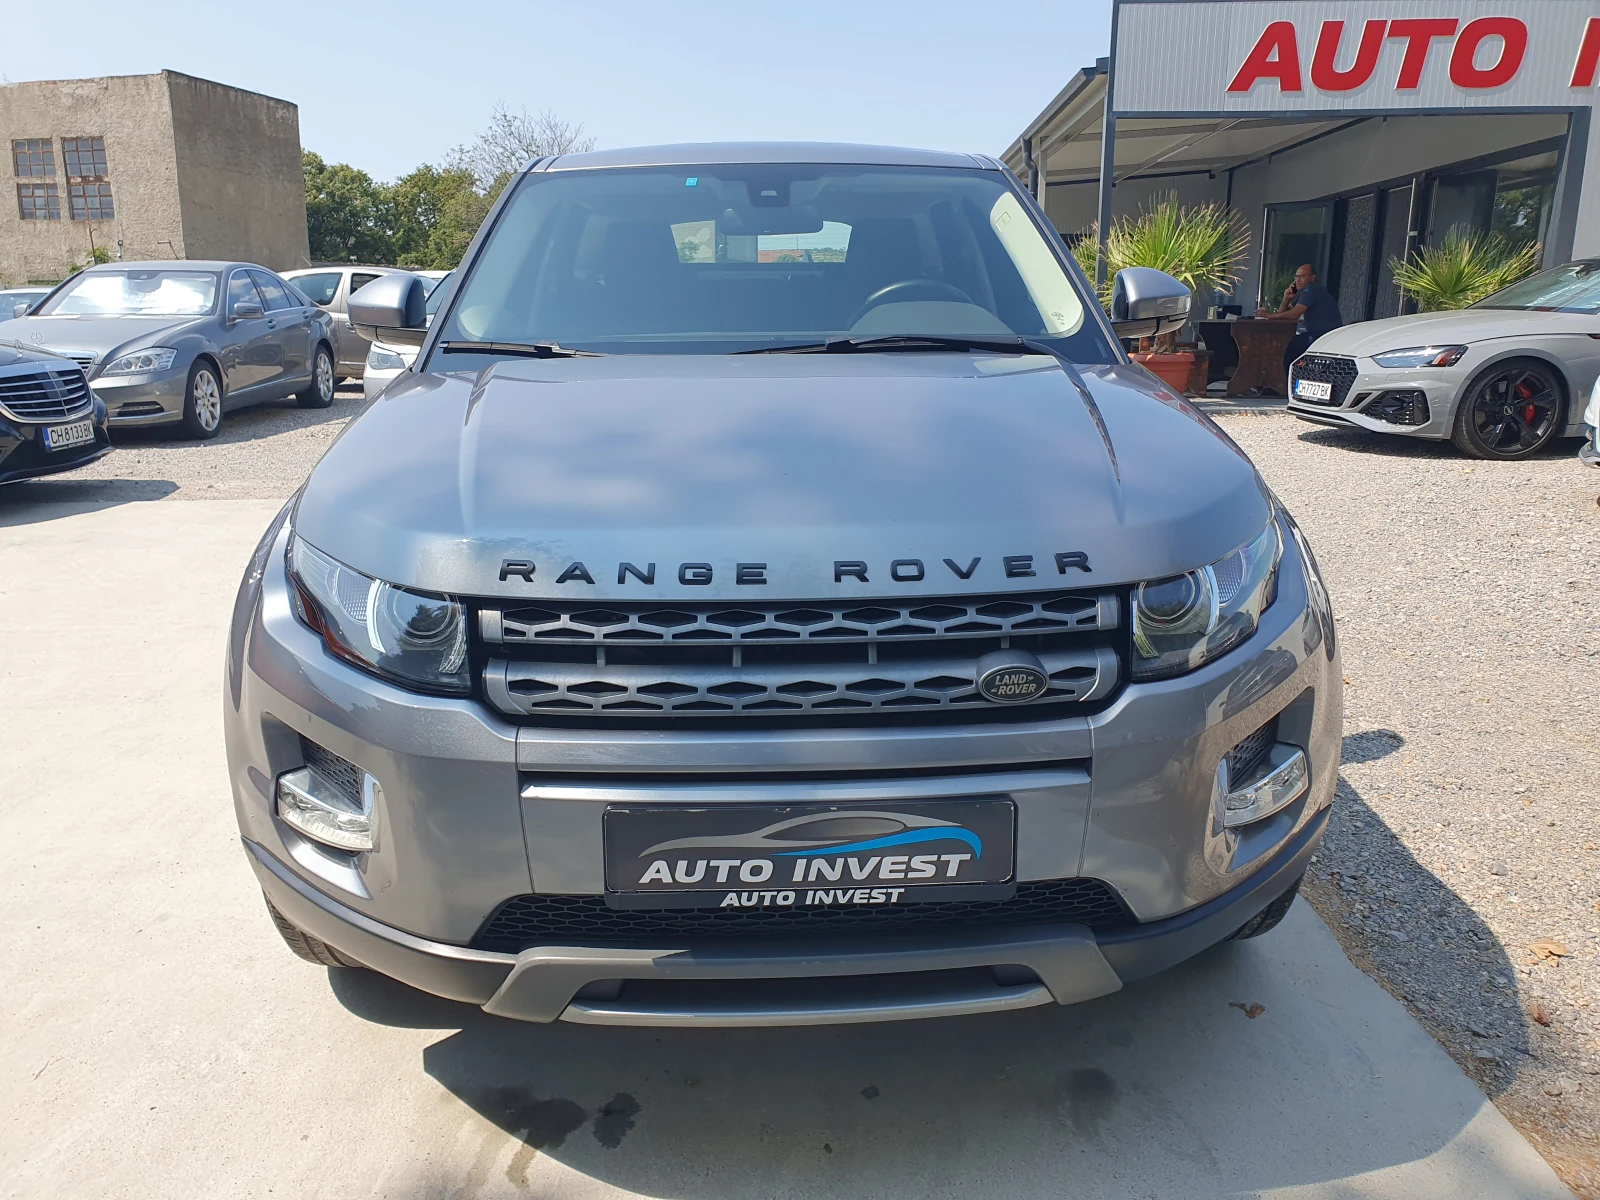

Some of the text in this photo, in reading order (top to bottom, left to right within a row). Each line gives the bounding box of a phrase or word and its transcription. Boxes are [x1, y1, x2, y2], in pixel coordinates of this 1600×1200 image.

[1226, 16, 1528, 92] AUTO
[499, 551, 1092, 585] RANGE ROVER
[995, 674, 1027, 685] LAND
[998, 684, 1036, 695] ROVER
[638, 854, 971, 883] AUTO INVEST
[720, 888, 905, 907] AUTO INVEST
